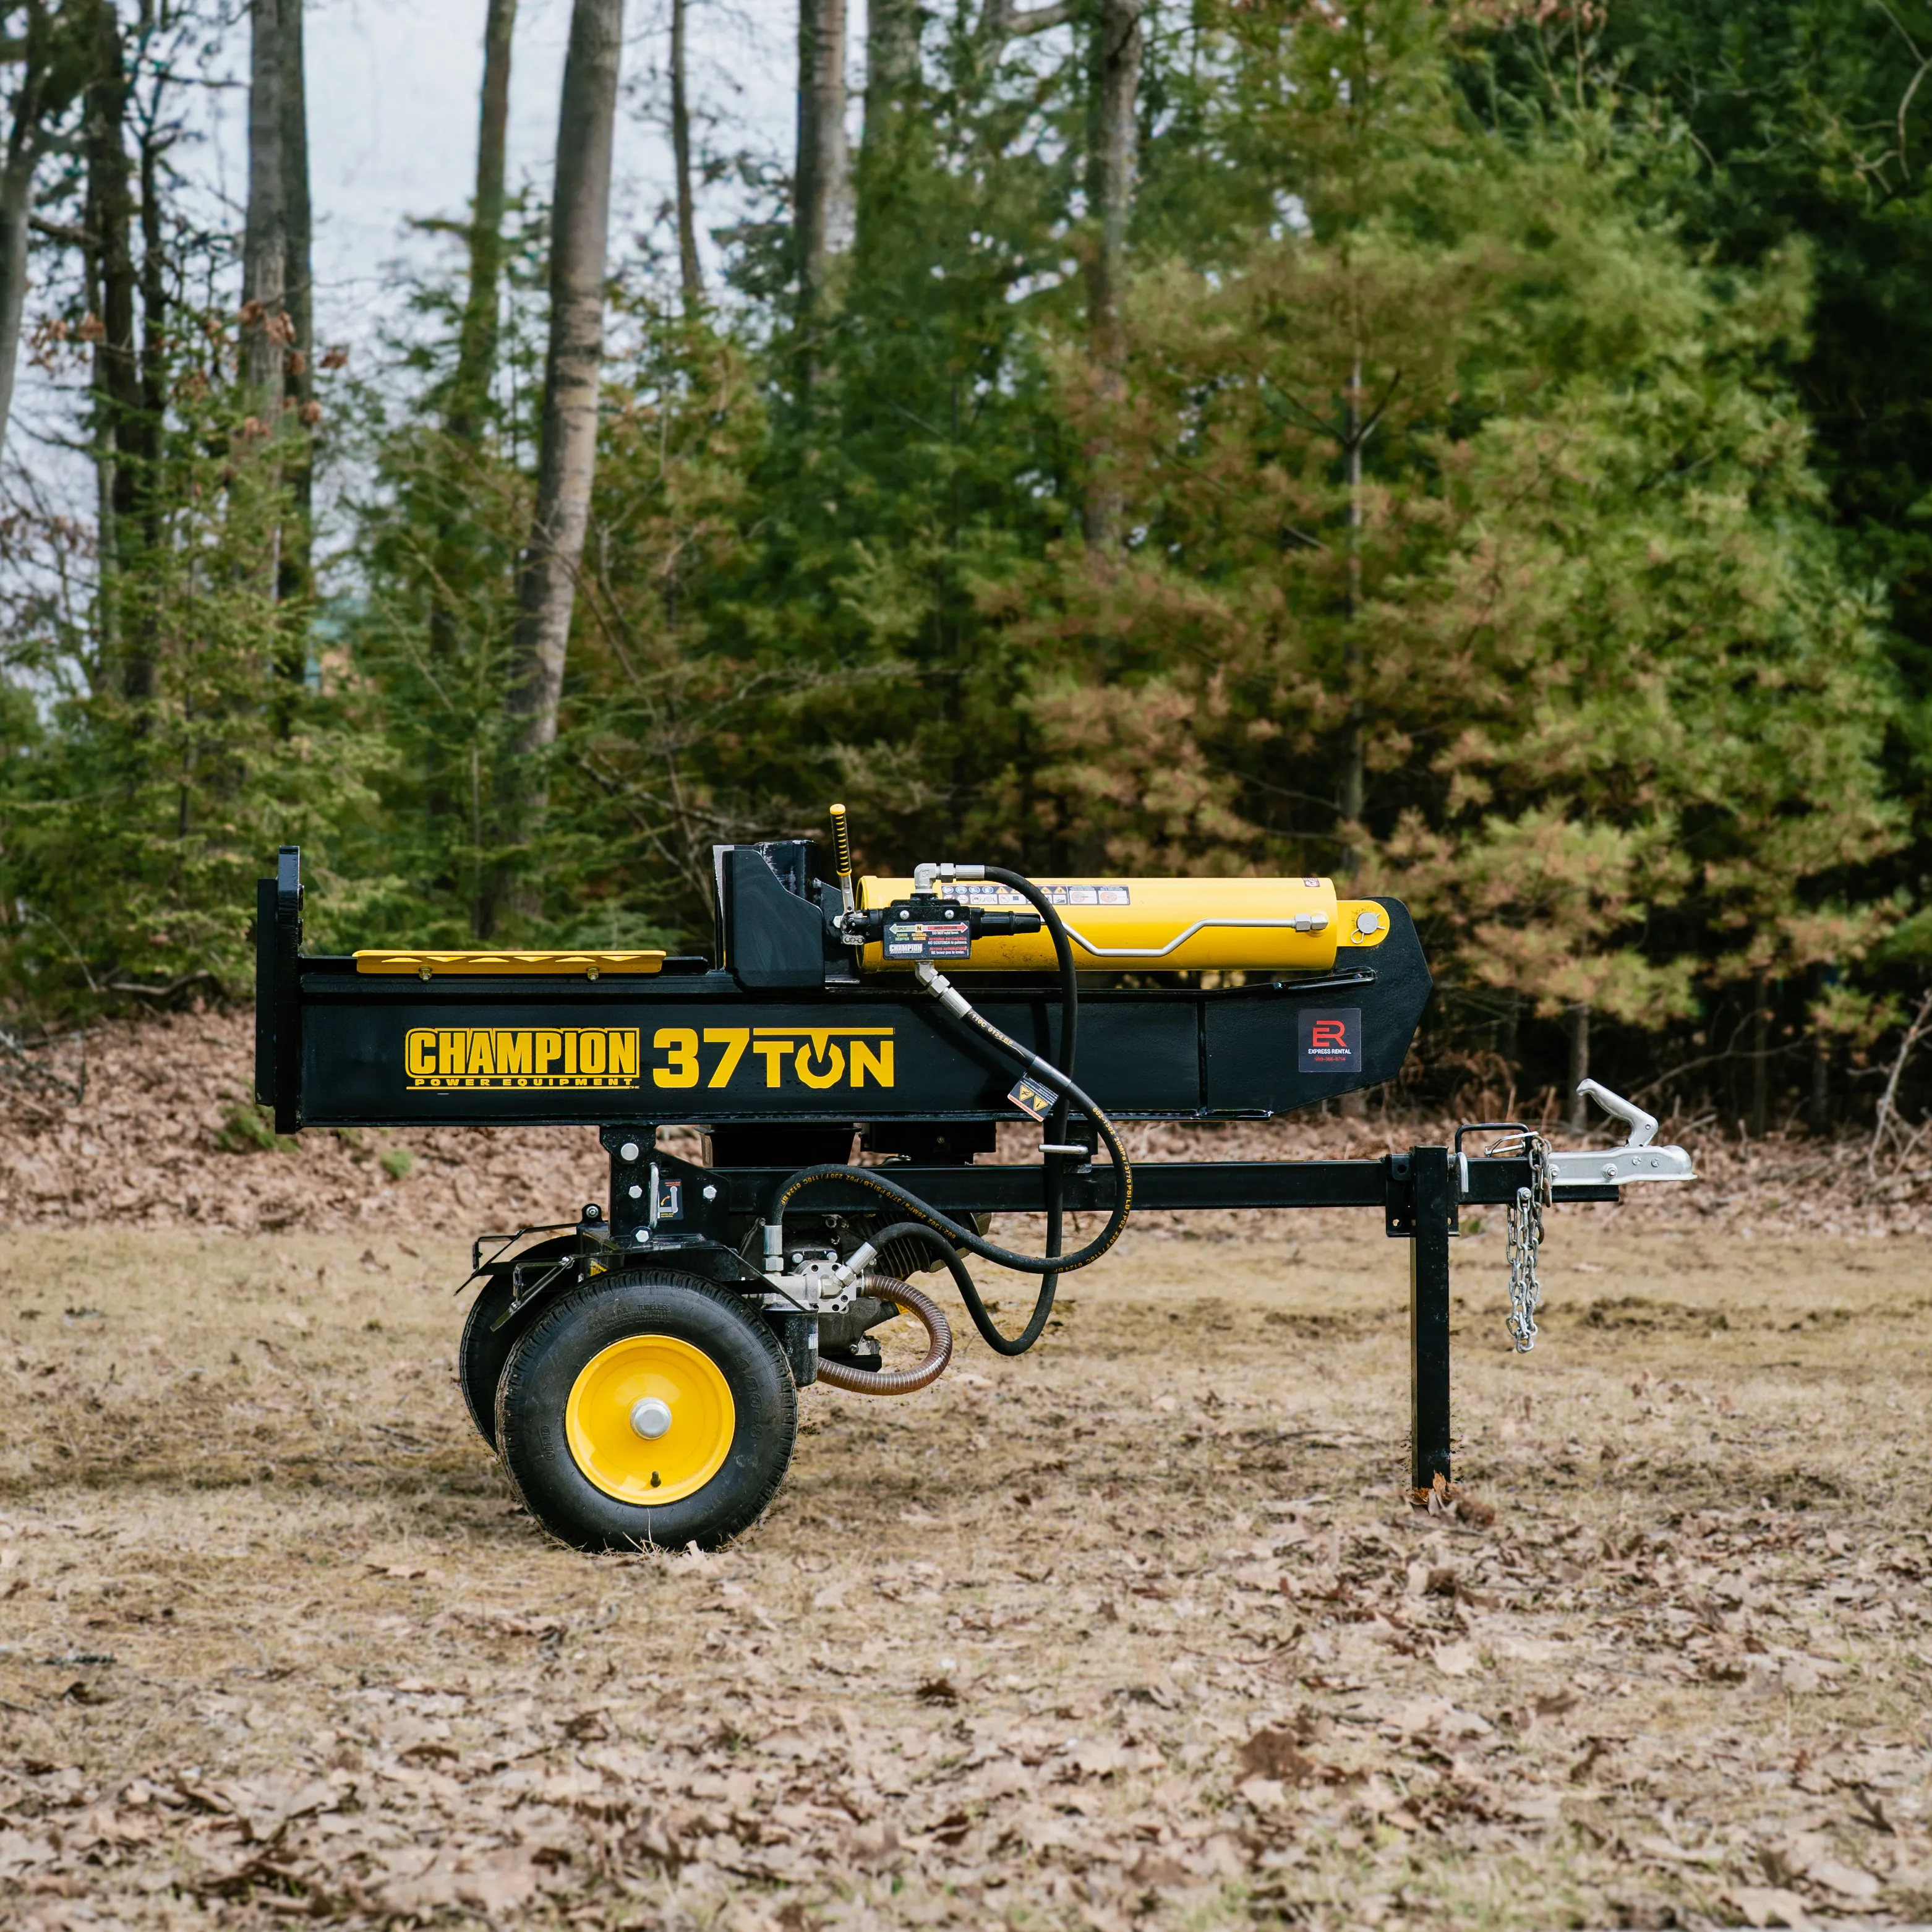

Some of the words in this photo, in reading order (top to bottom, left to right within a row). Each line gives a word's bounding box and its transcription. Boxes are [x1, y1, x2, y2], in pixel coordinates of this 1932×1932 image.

[889, 944, 923, 952] CHAMPION
[1312, 1020, 1347, 1047] ER
[409, 1031, 636, 1075] CHAMPION
[652, 1028, 750, 1088] 37
[753, 1038, 894, 1089] TON
[415, 1079, 491, 1087] POWER
[503, 1078, 633, 1087] EQUIPMENT
